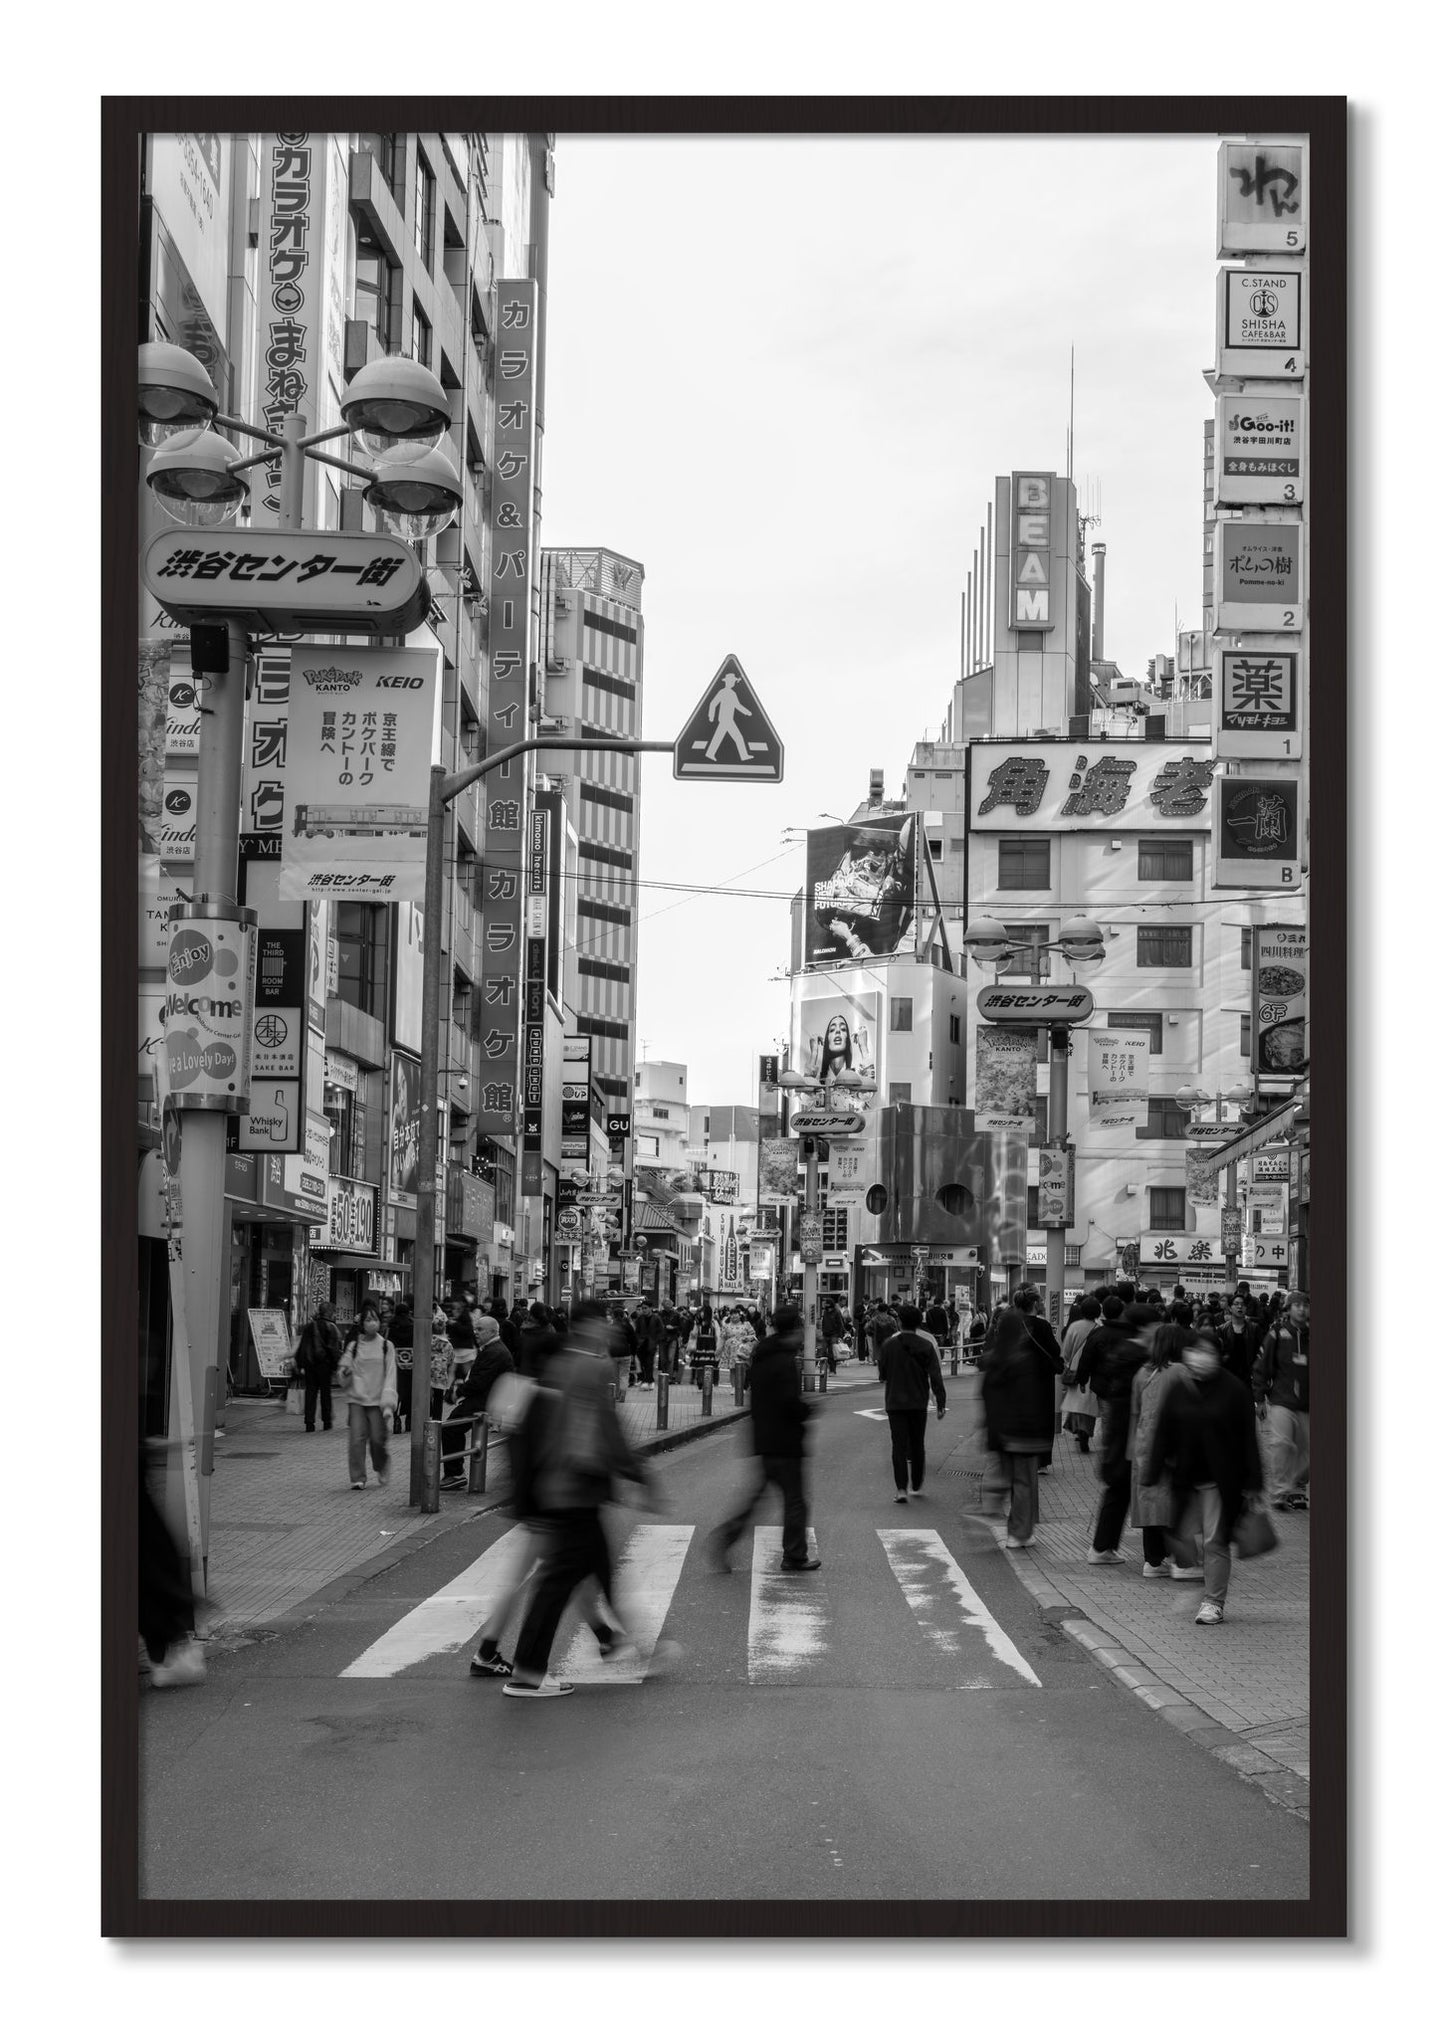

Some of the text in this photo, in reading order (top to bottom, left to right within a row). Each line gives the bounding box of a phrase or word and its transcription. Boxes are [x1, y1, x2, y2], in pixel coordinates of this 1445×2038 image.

[270, 146, 310, 284] カラオケ
[1286, 231, 1298, 246] 5
[1241, 278, 1287, 288] C.STAND
[1241, 319, 1286, 329] SHISHA
[1241, 330, 1286, 338] CAFE&BAR
[1284, 356, 1297, 372] 4
[1233, 436, 1291, 445] 渋谷宇田川町店
[1228, 461, 1296, 473] 全身もみほぐし
[1284, 484, 1296, 500] 3
[1018, 477, 1049, 622] BEAM
[157, 549, 405, 587] 渋谷センター街
[1283, 611, 1295, 627] 2
[315, 684, 351, 692] KANTO
[376, 676, 424, 689] KEIO
[1232, 659, 1283, 711] 薬
[1226, 713, 1288, 728] マツモトキヨシ
[320, 711, 338, 755] 冒険へ
[170, 739, 195, 748] 渋谷店
[338, 711, 357, 786] カントーの
[359, 711, 377, 786] ポケパーク
[380, 711, 399, 772] 京王線で
[1283, 739, 1292, 754] 1
[977, 756, 1217, 816] 角海老
[534, 814, 543, 850] kimono
[166, 846, 190, 855] 渋谷店
[307, 874, 396, 887] 渋谷センター街
[1281, 867, 1293, 882] B
[266, 941, 281, 949] THE
[170, 943, 210, 977] Enjoy
[262, 949, 285, 957] THIRD
[261, 977, 284, 985] ROOM
[265, 987, 280, 995] BAR
[482, 870, 520, 1113] カラオケ館
[166, 993, 243, 1018] Welcome
[984, 994, 1087, 1008] 渋谷センター街
[1259, 1004, 1288, 1023] 6F
[183, 1050, 213, 1070] Lovely
[214, 1051, 235, 1068] Day!
[250, 1115, 283, 1128] Whisky
[609, 1120, 629, 1131] GU
[249, 1126, 270, 1135] Bank
[1154, 1238, 1213, 1260] 兆楽
[726, 1237, 736, 1280] BEER
